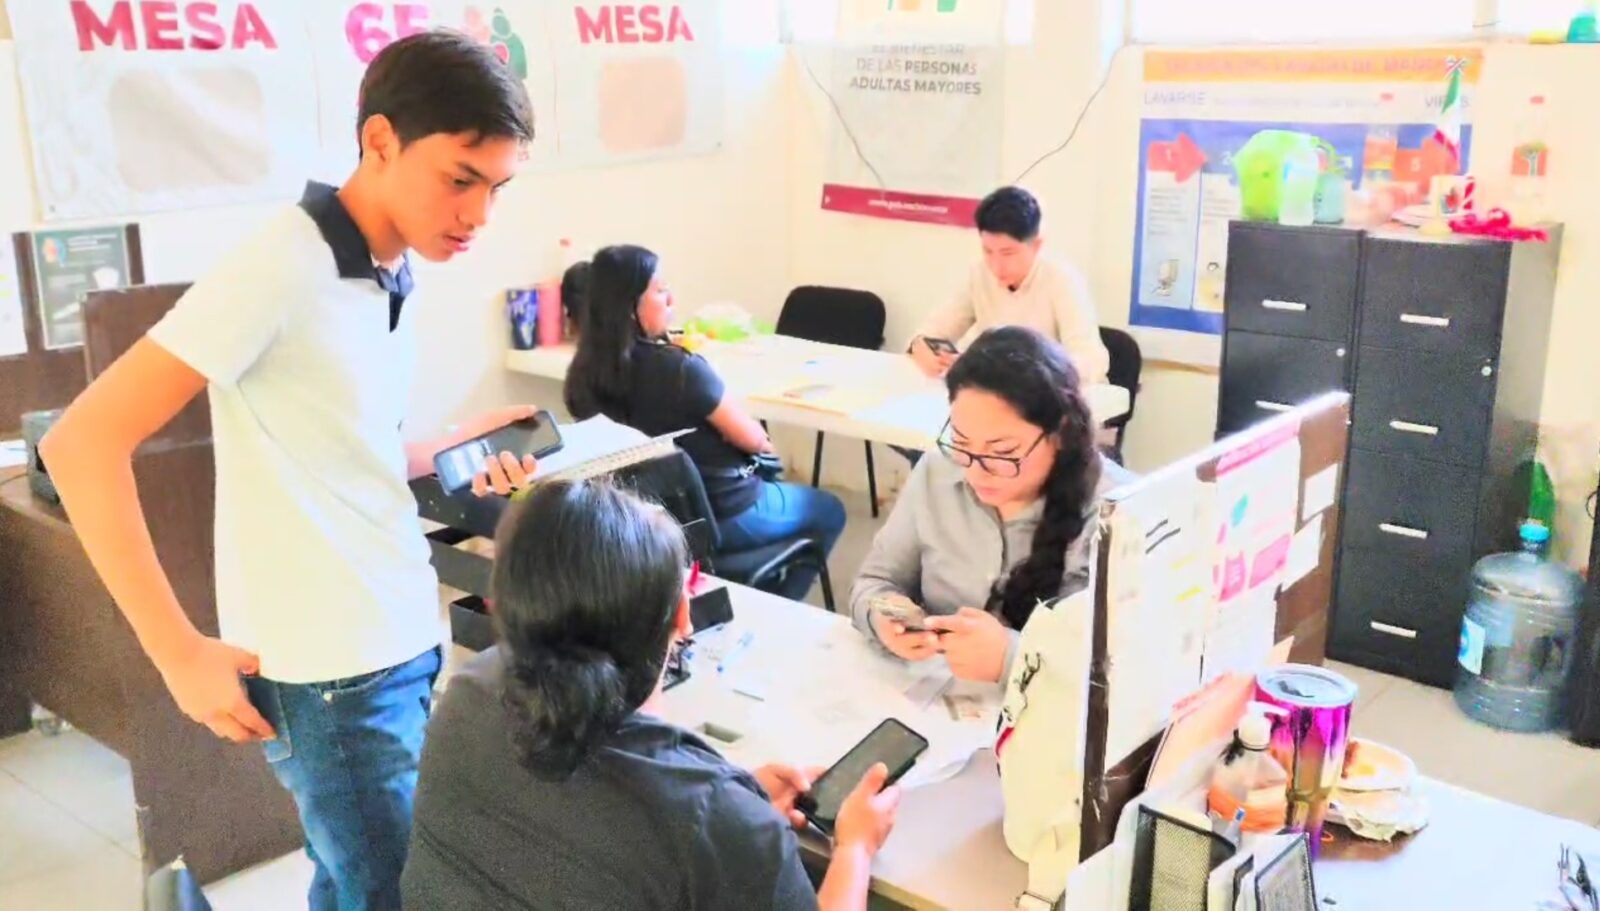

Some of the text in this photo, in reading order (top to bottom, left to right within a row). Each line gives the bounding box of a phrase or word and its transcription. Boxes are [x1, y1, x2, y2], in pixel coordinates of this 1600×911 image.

[69, 0, 278, 51] MESA
[574, 5, 694, 43] MESA
[856, 58, 875, 71] DE
[905, 60, 976, 75] PERSONAS
[850, 77, 982, 95] ADULTAS MAYORES
